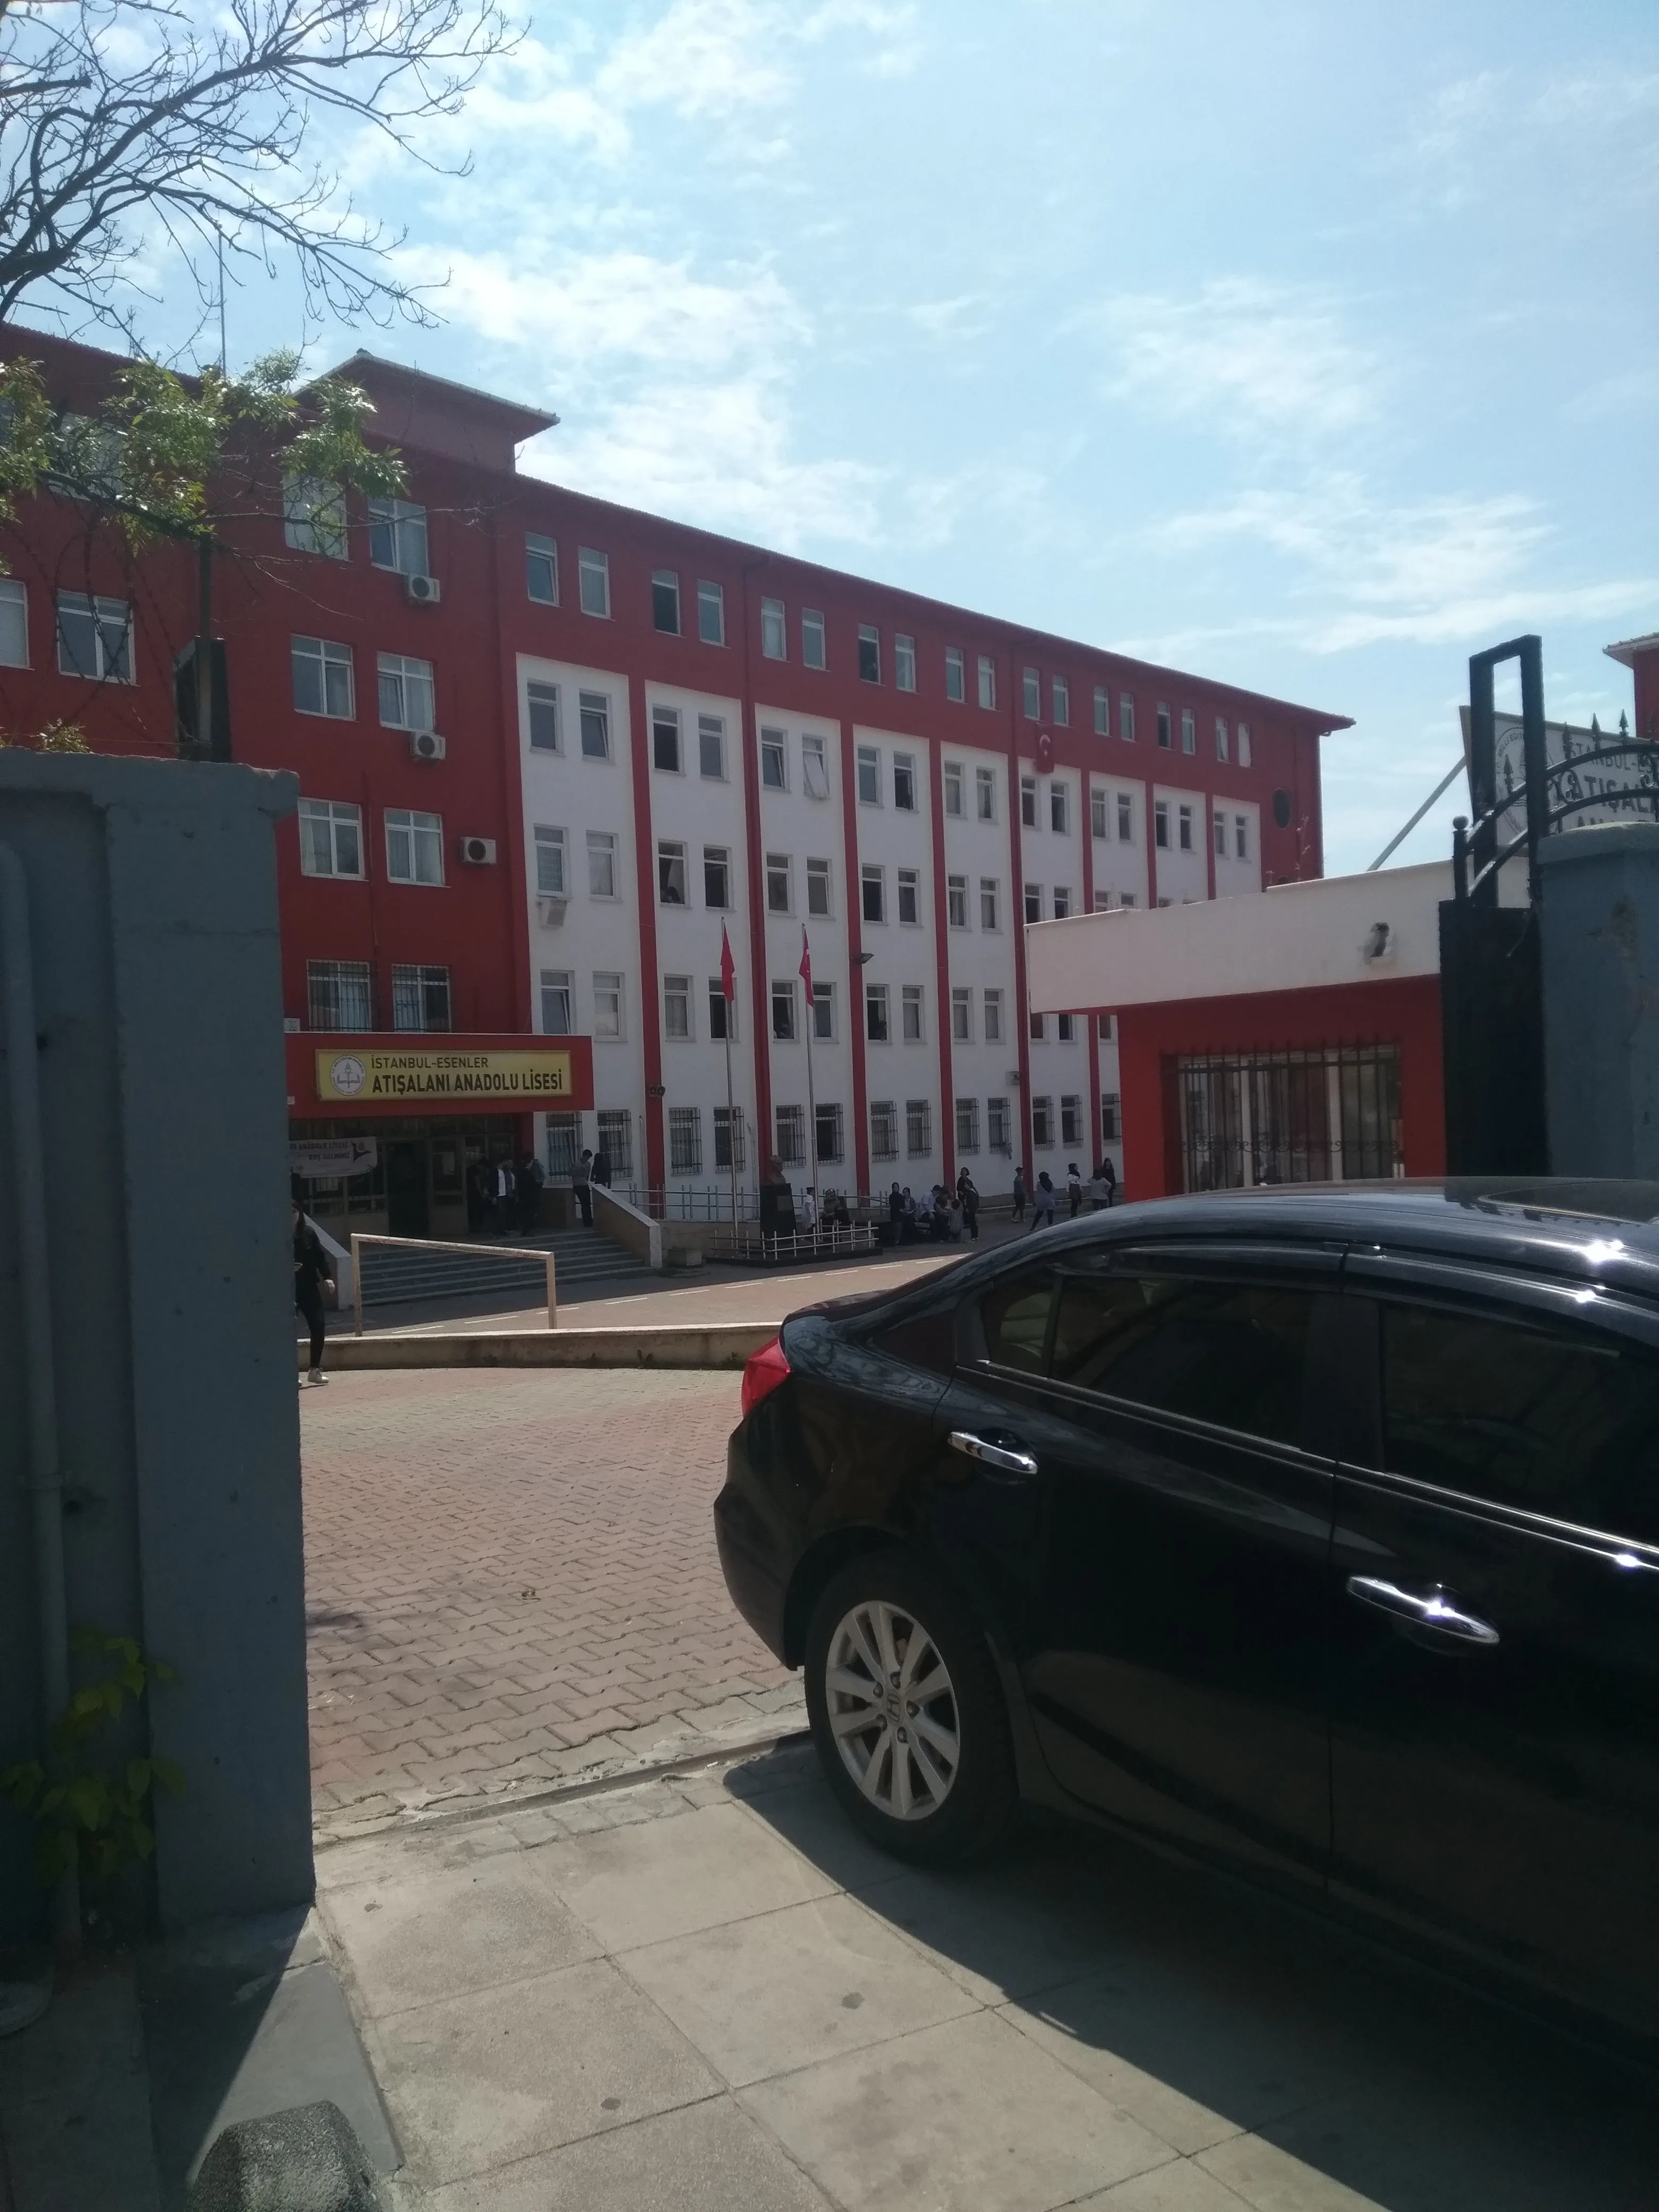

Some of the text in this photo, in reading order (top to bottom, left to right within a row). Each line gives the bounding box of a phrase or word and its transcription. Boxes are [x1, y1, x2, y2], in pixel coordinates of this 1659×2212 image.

[372, 1055, 488, 1069] İSTANBUL-ESENLER
[372, 1074, 450, 1095] ATIŞALANI
[454, 1074, 519, 1091] ANADOLU
[522, 1069, 563, 1090] LİSESİ
